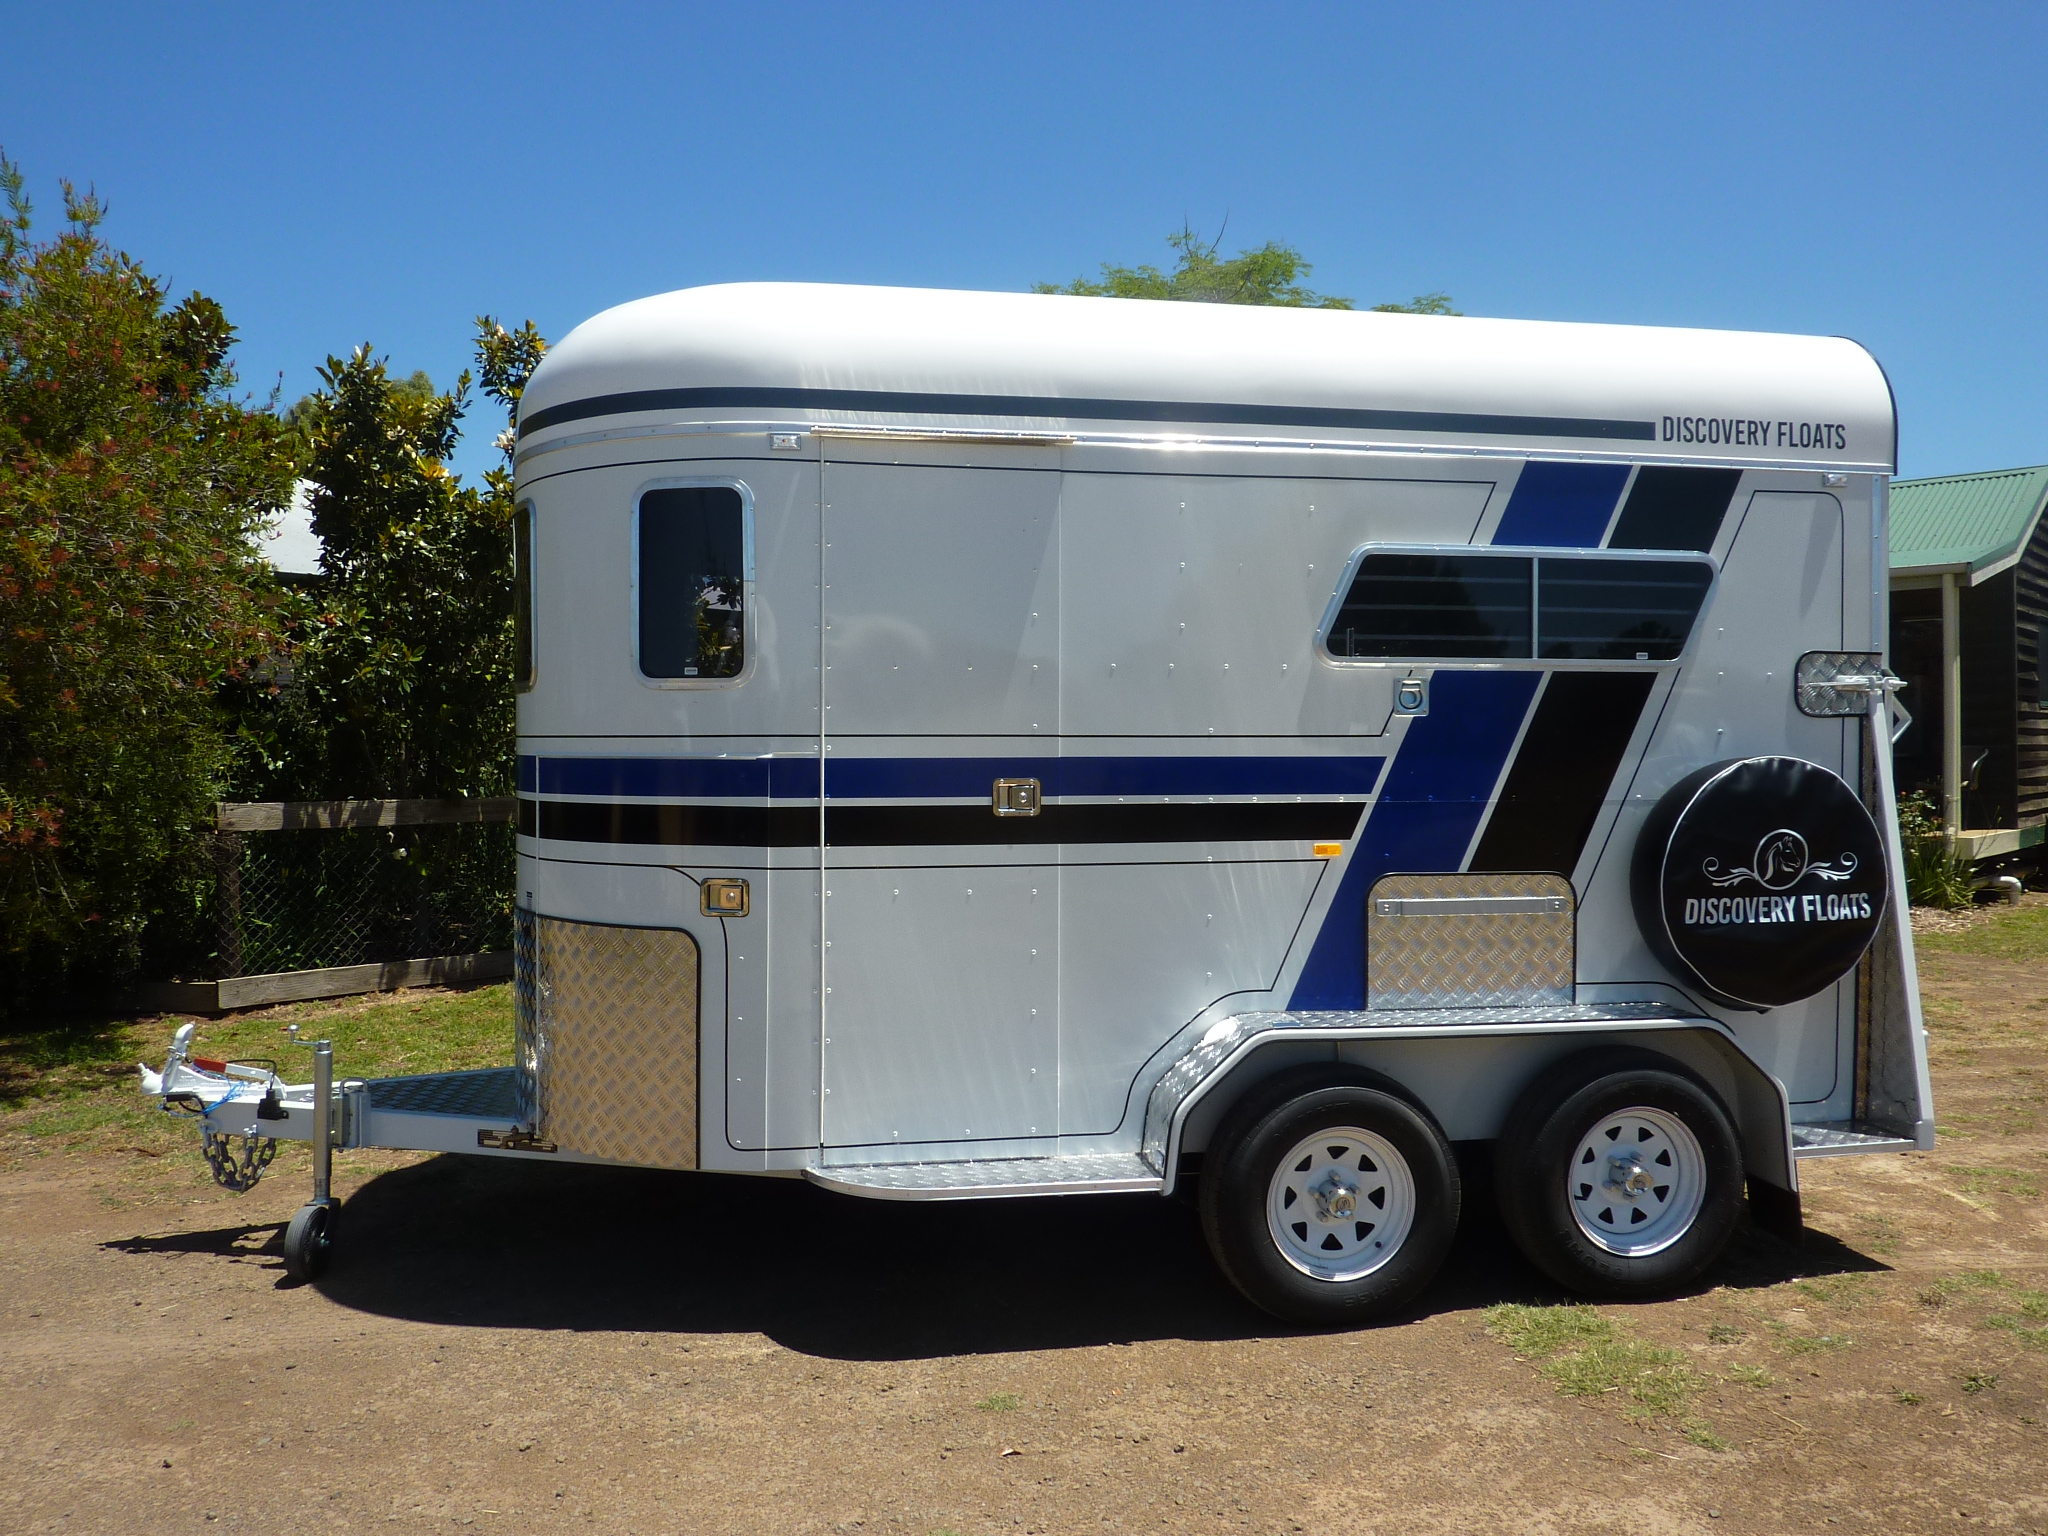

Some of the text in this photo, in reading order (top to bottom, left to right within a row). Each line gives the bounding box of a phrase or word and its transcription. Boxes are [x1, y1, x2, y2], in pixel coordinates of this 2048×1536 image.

[1663, 416, 1846, 449] DISCOVERY FLOATS
[1684, 892, 1871, 924] DISCOVERY FLOATS
